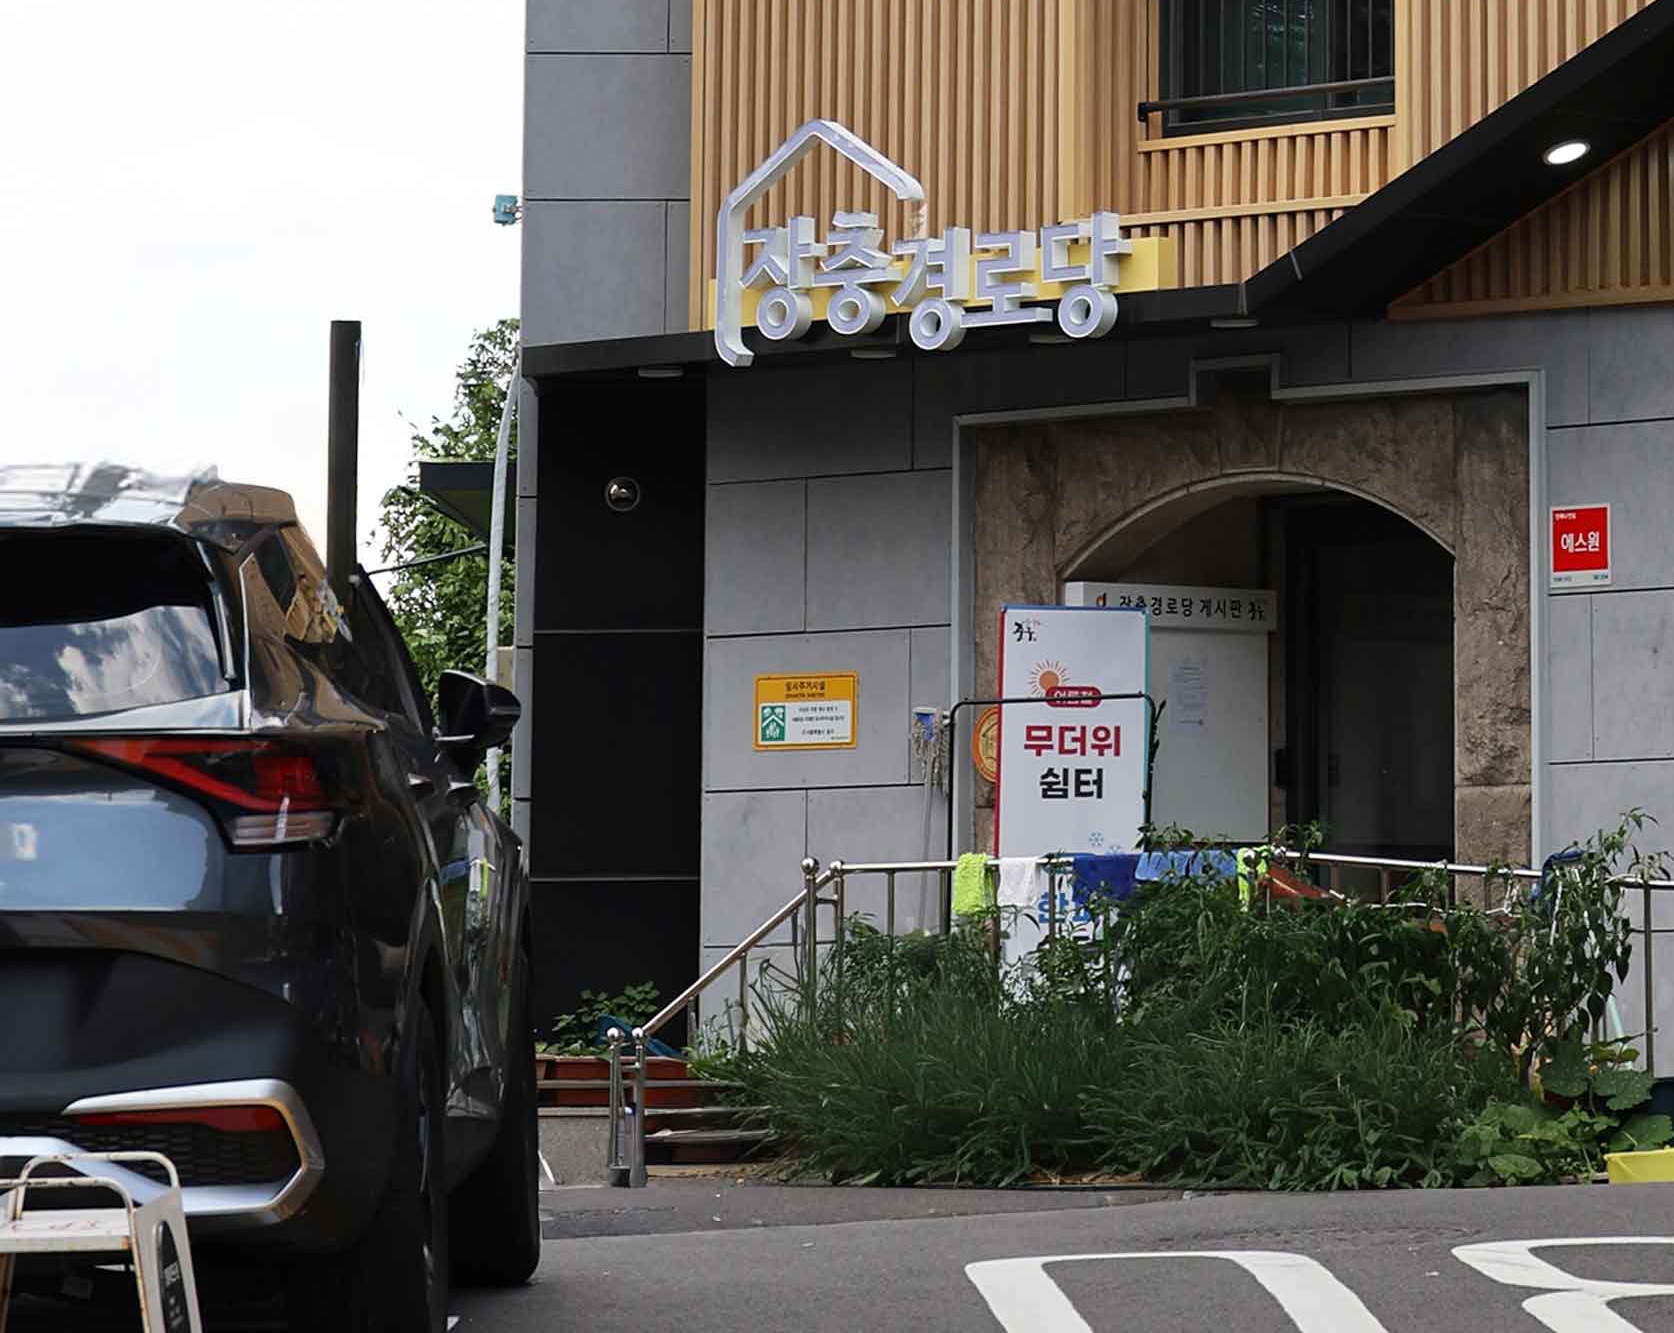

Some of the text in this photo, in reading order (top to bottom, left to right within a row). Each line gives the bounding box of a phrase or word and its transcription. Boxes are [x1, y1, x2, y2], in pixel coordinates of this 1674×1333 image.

[738, 211, 1132, 351] 장충경로당
[1560, 530, 1600, 554] 에스원
[1199, 597, 1242, 619] 게시판
[1023, 725, 1121, 758] 무더위
[1039, 767, 1104, 800] 쉼터
